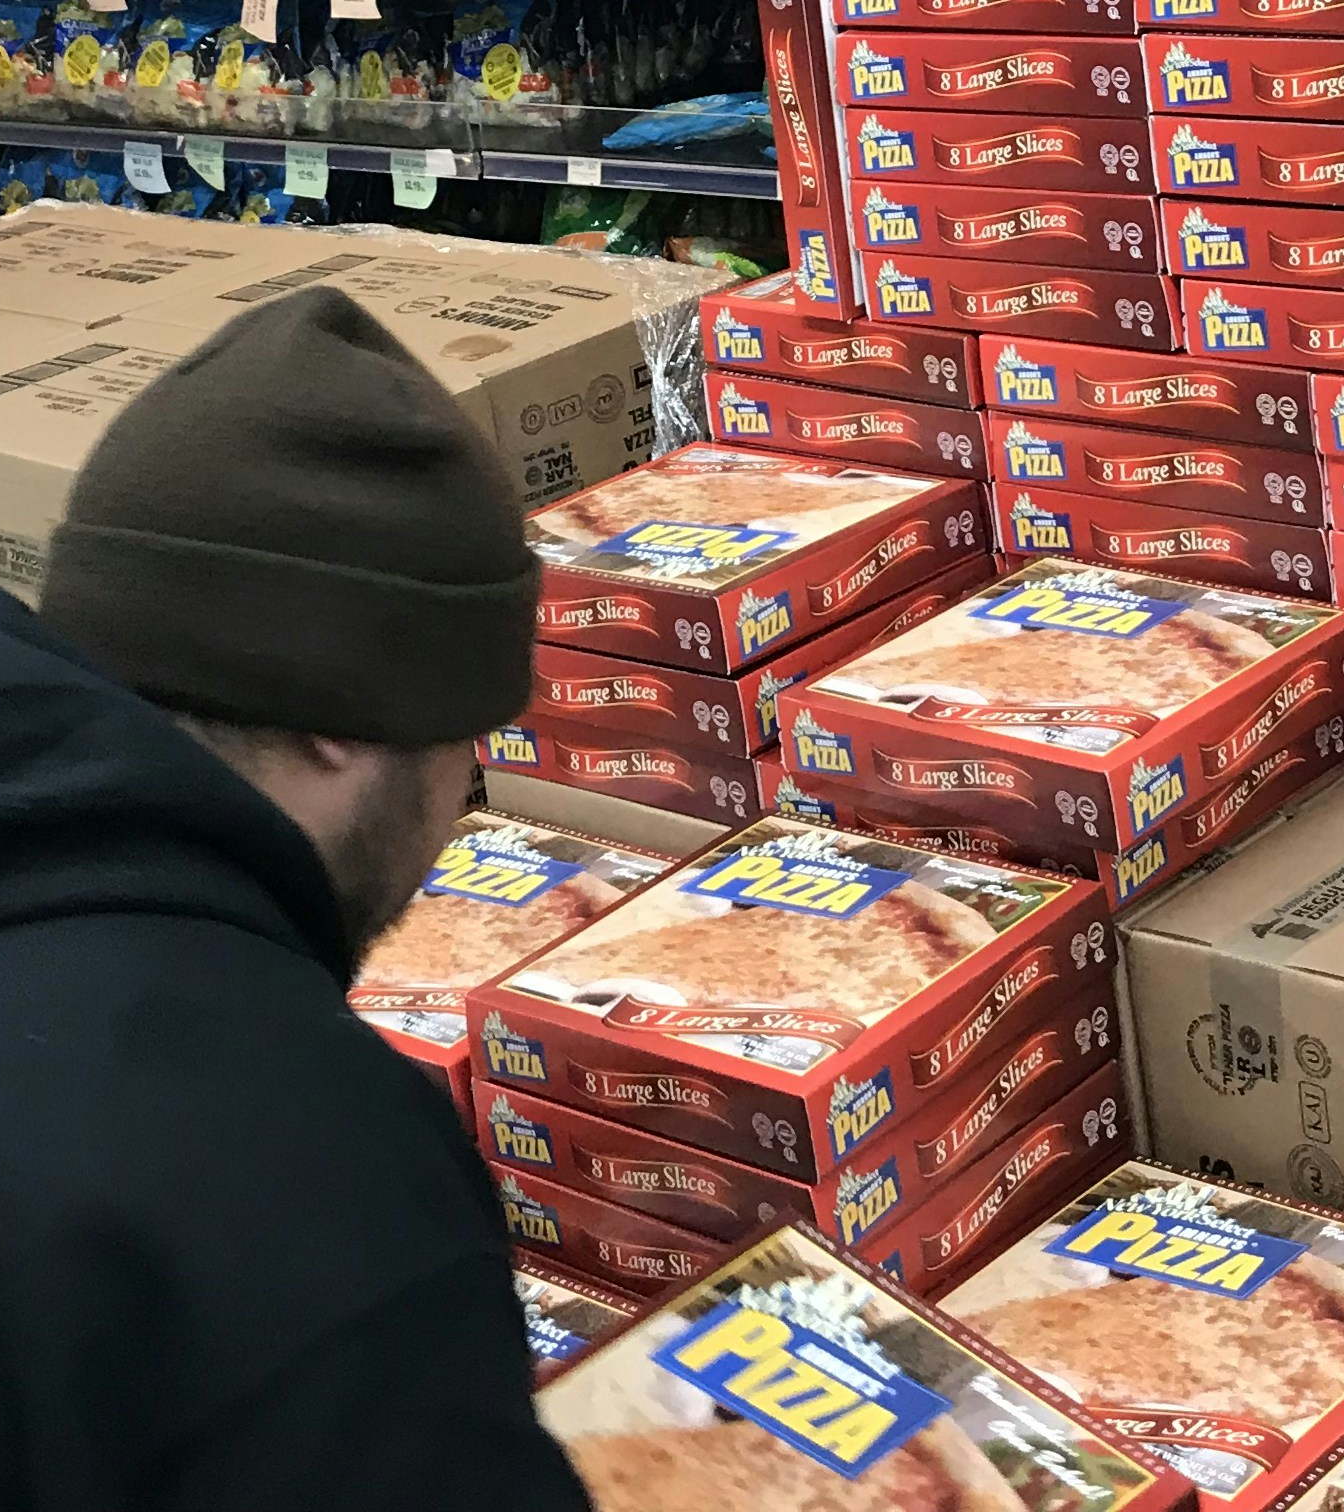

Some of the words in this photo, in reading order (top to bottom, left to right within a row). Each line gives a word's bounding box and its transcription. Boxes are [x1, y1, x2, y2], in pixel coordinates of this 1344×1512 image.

[779, 48, 797, 106] Slices
[1167, 74, 1230, 103] PIZZA
[1272, 78, 1286, 100] 8
[790, 109, 815, 169] Large
[802, 173, 815, 188] 8
[1065, 1212, 1265, 1291] PIZZA
[1162, 1418, 1265, 1446] Slices
